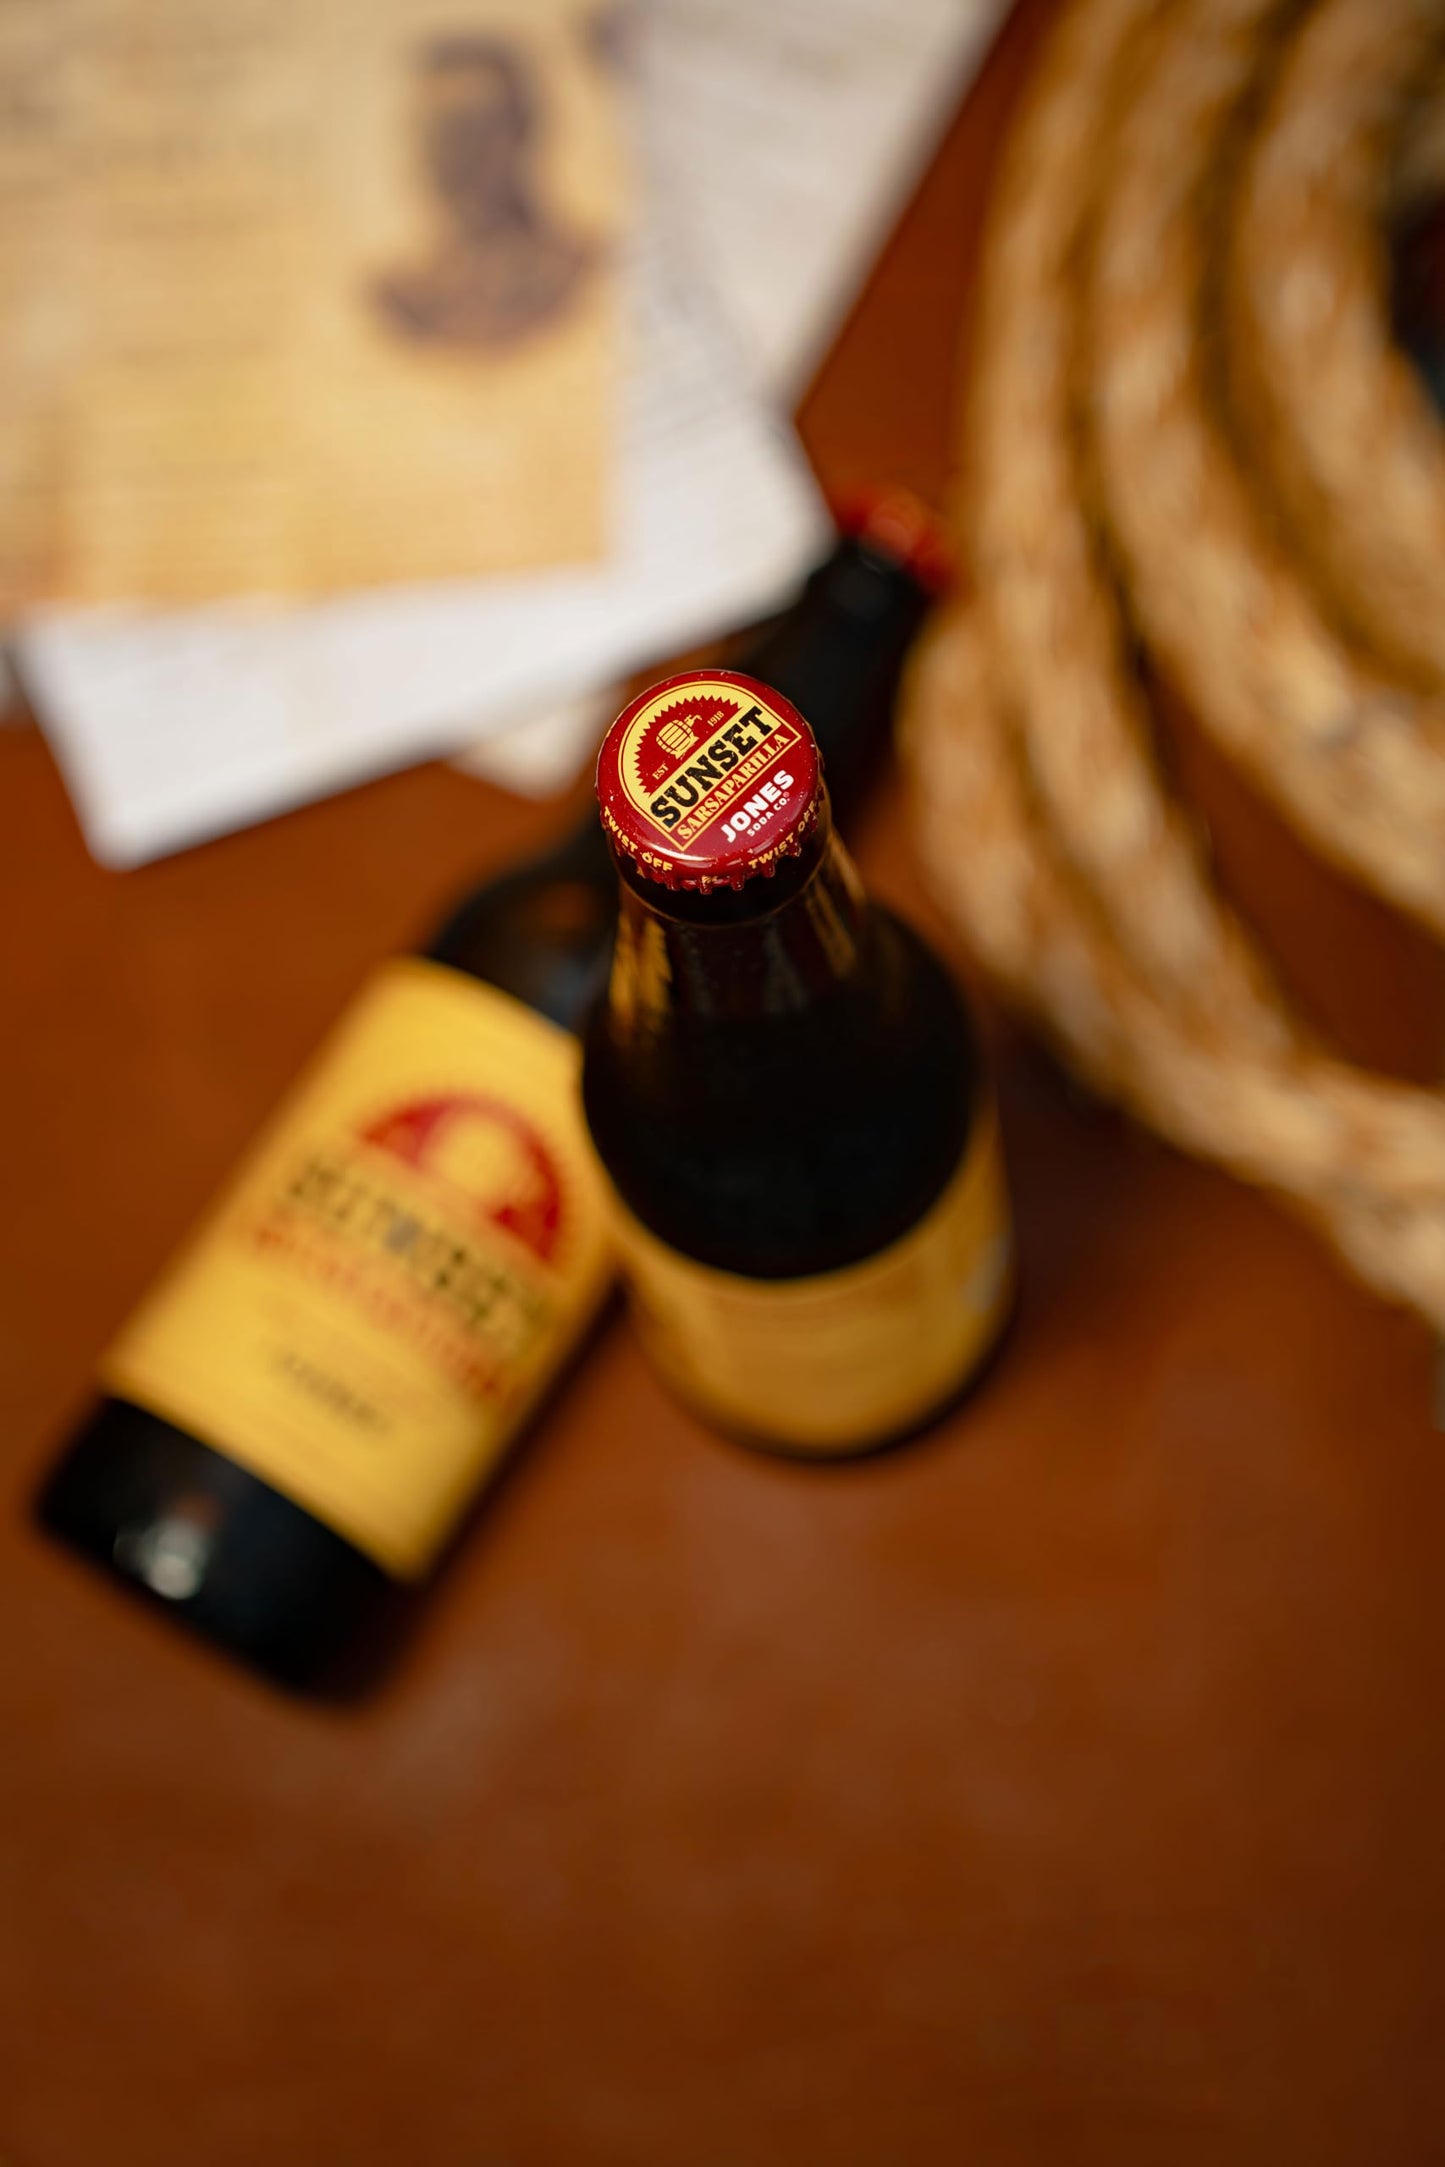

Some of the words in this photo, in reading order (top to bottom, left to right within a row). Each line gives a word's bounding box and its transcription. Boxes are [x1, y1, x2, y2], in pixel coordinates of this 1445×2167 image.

[707, 711, 725, 728] 1918
[650, 705, 772, 828] SUNSET
[652, 764, 669, 780] EST
[677, 735, 790, 840] SARSAPARILLA
[721, 770, 795, 843] JONES
[747, 811, 774, 837] SODA
[603, 806, 638, 852] TWIST
[643, 853, 673, 872] OFF
[748, 835, 795, 870] TWIST
